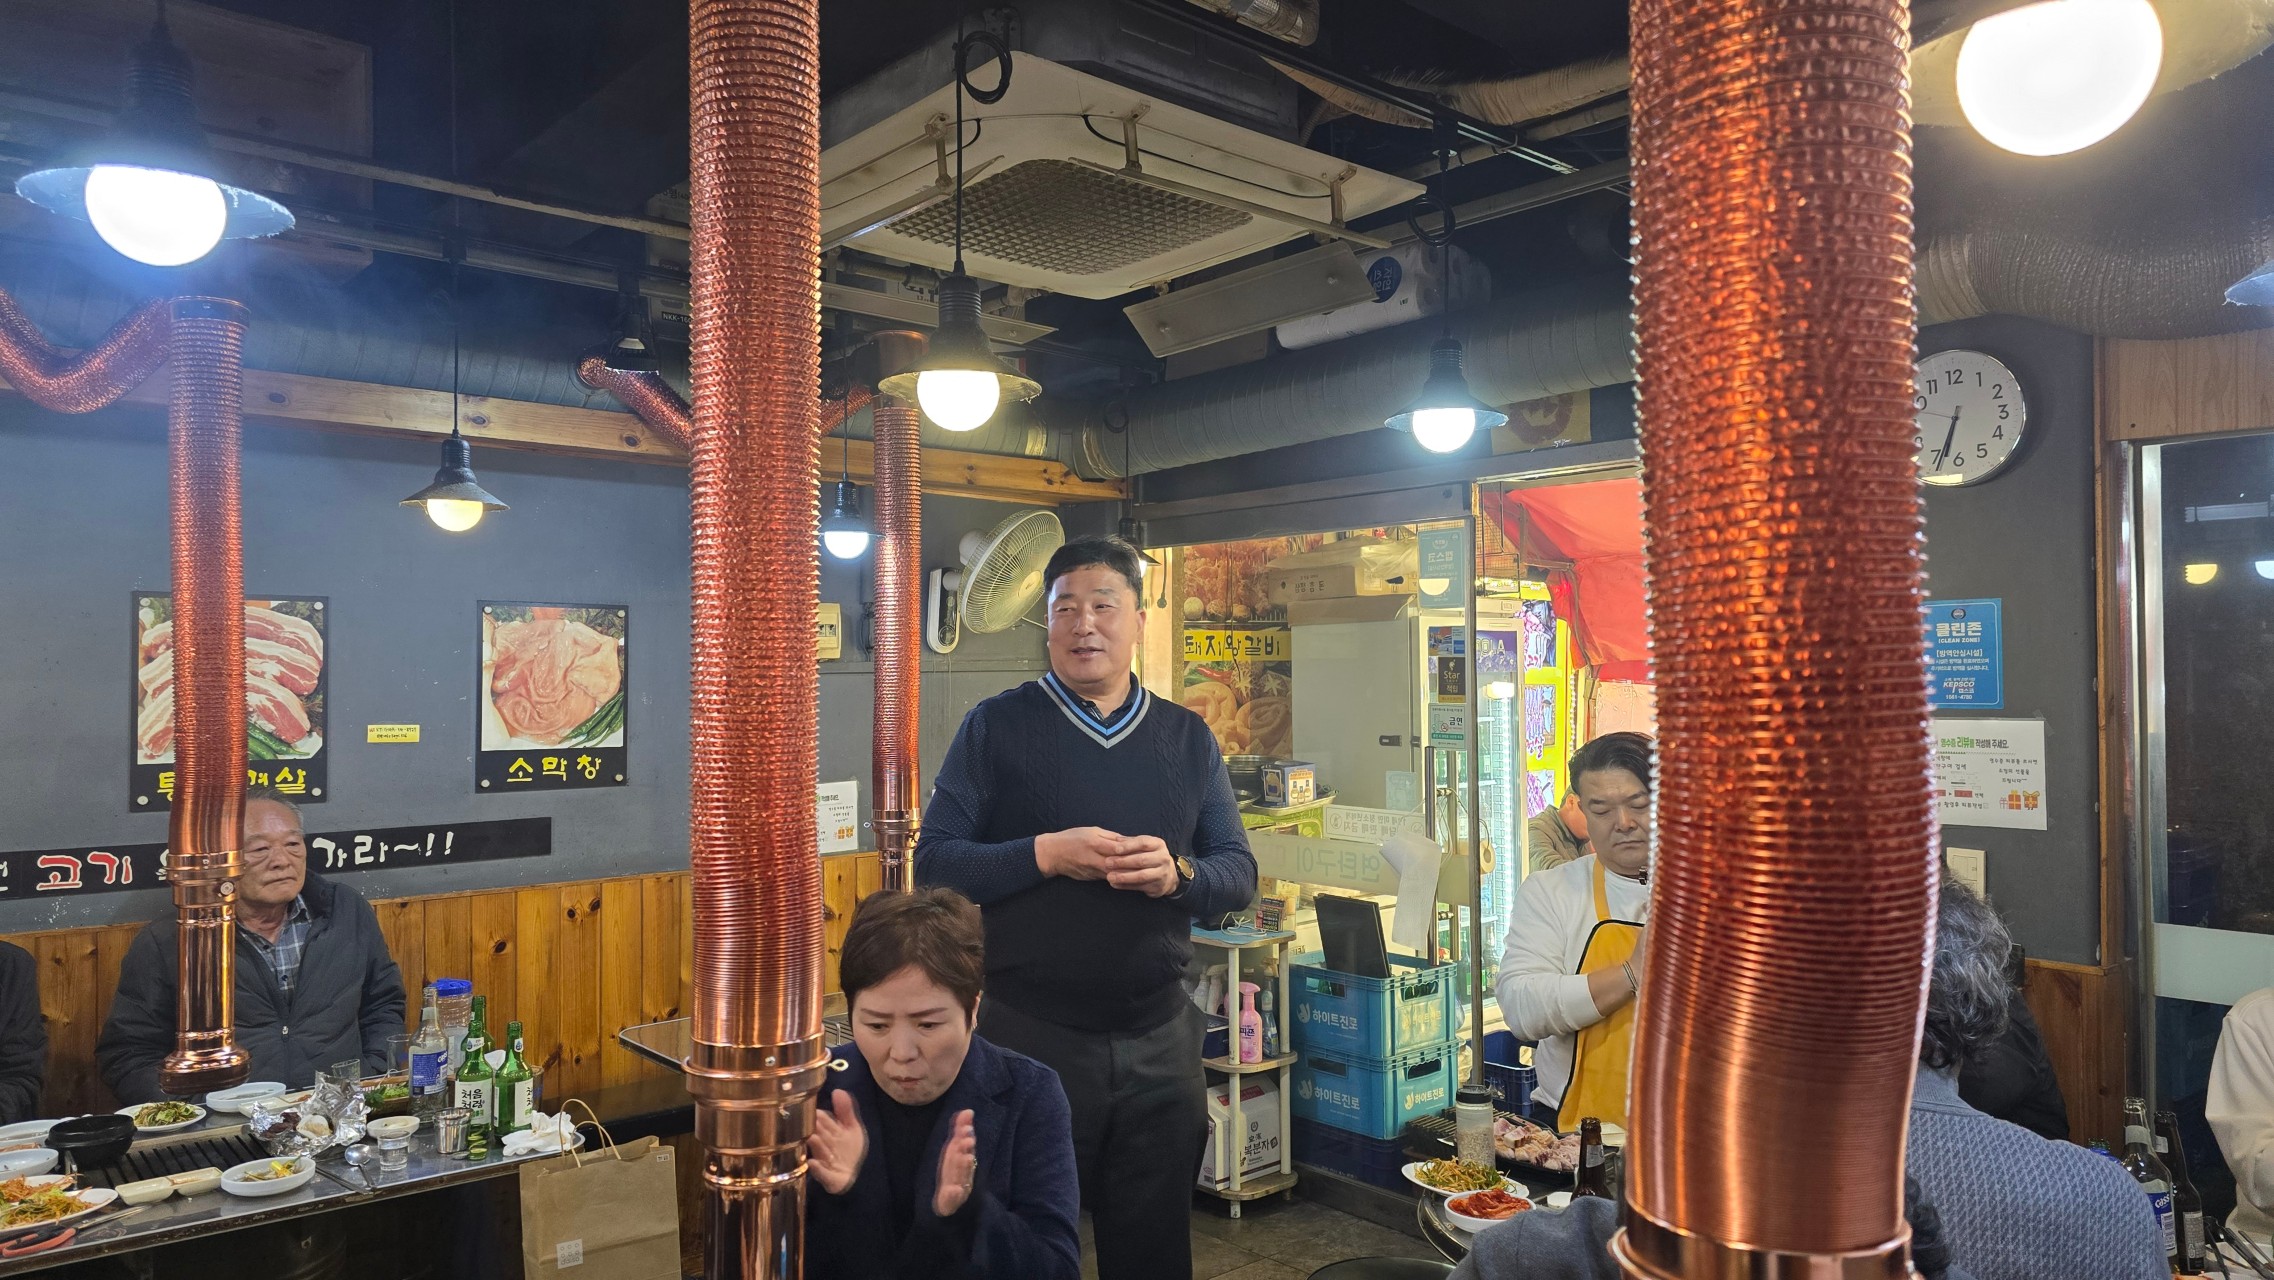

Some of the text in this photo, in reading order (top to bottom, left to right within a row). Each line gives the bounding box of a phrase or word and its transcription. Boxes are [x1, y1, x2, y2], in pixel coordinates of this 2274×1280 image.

[1945, 369, 1964, 385] 12
[1975, 372, 1983, 387] 1
[1926, 379, 1938, 395] 11
[1992, 384, 2004, 399] 2
[1998, 404, 2010, 419] 3
[1991, 425, 2004, 440] 4
[1930, 449, 1942, 465] 7
[1976, 443, 1988, 458] 5
[1953, 452, 1965, 467] 6
[1936, 622, 1982, 637] 클린존
[1184, 635, 1280, 657] 돼지왕갈비
[1443, 670, 1461, 680] Star
[1449, 716, 1463, 726] 금연
[507, 754, 602, 783] 소막창
[36, 851, 133, 891] 고기
[1312, 1008, 1359, 1031] 하이트진로
[461, 1088, 483, 1100] 처음
[1314, 1086, 1361, 1111] 하이트진로
[1415, 1087, 1445, 1103] 하이트진로
[461, 1100, 483, 1110] 처럼
[1244, 1138, 1270, 1156] 복분자
